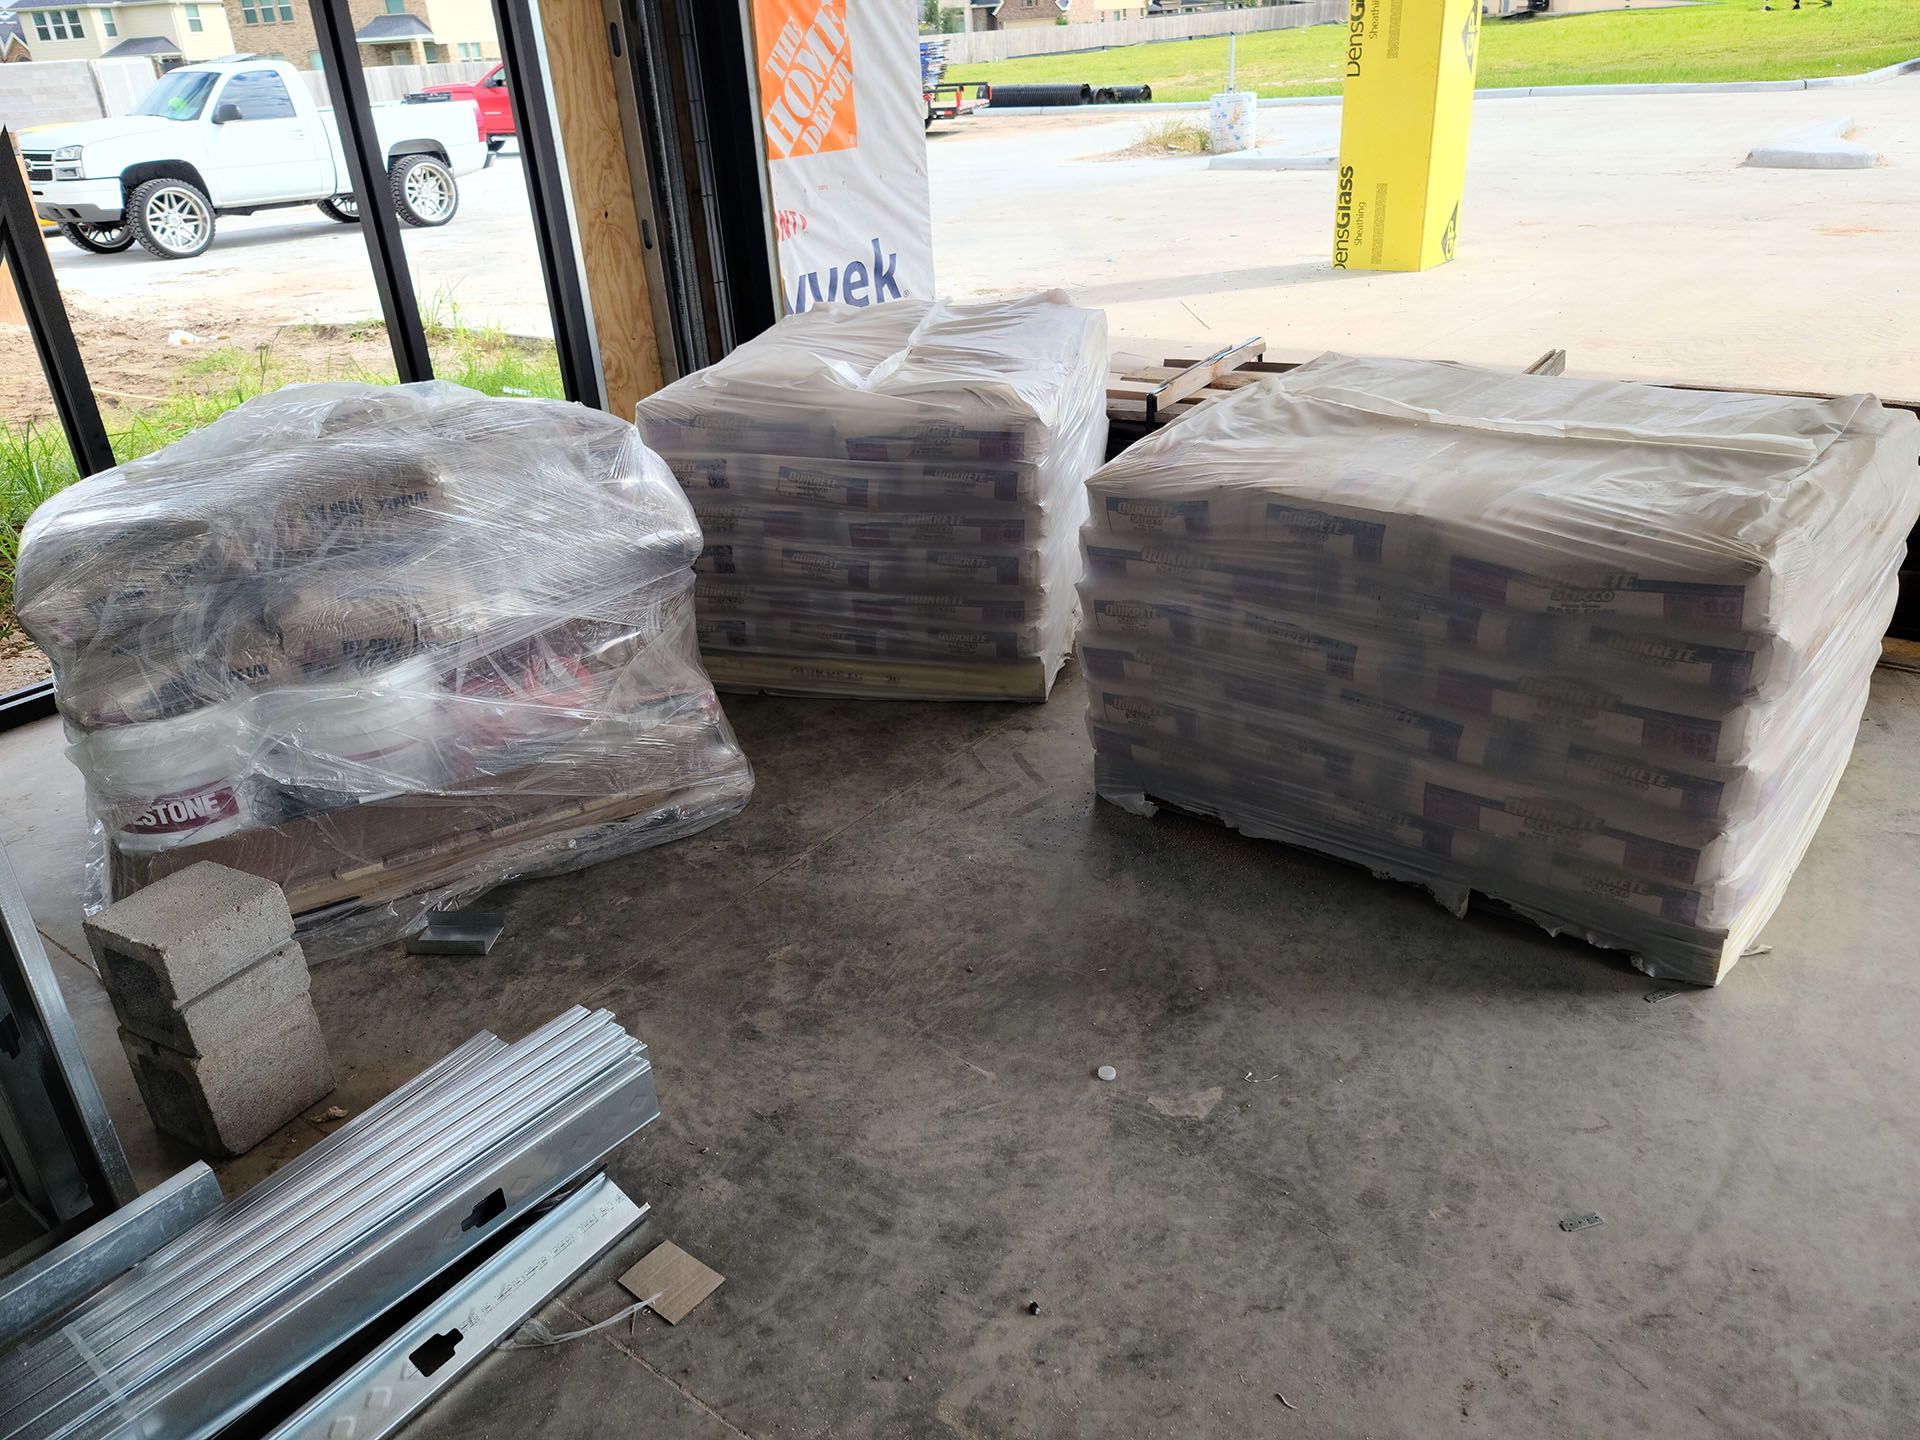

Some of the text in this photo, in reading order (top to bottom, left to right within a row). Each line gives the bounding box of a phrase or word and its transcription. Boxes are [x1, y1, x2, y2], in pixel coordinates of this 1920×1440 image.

[764, 0, 849, 156] HOME
[766, 17, 804, 80] THE
[802, 53, 854, 153] DEPOT
[1354, 201, 1367, 246] Sheathing
